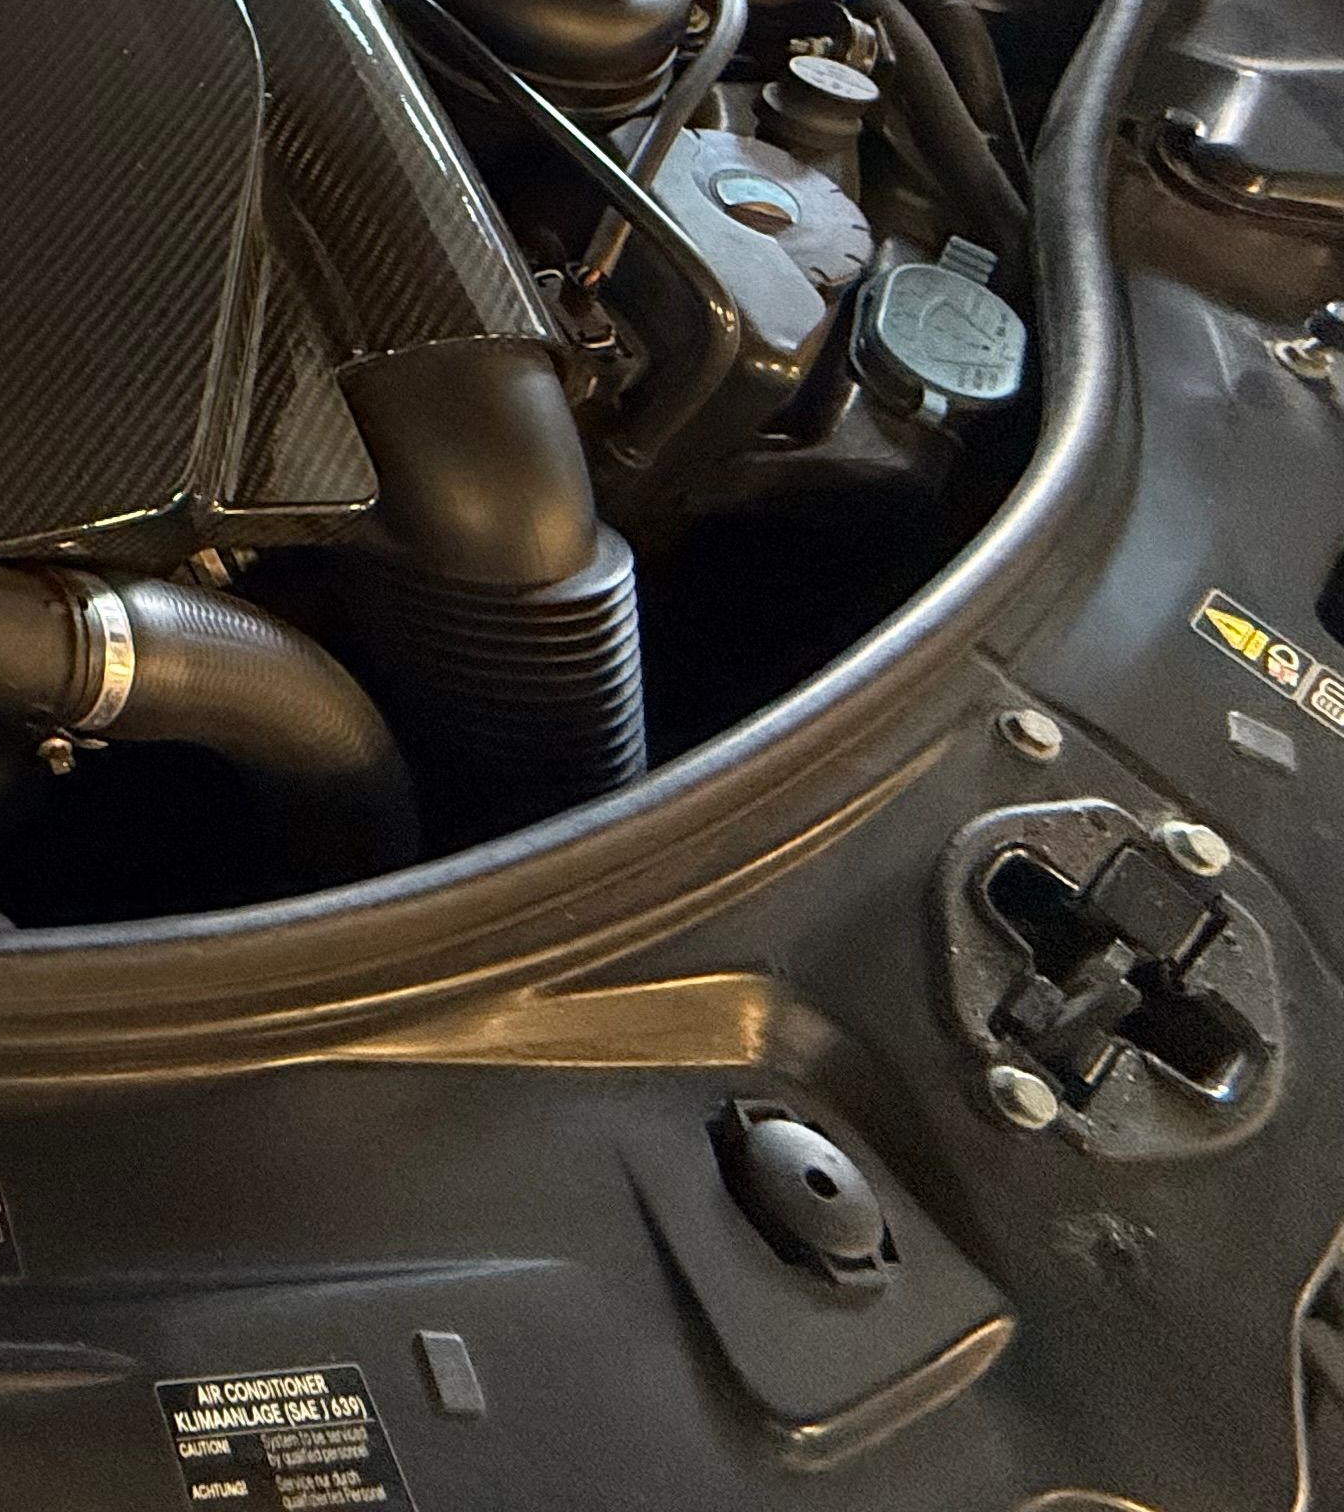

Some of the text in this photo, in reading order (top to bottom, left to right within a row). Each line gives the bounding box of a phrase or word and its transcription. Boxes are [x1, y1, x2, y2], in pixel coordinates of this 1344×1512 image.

[196, 1374, 330, 1406] AIR CONDITIONER
[174, 1402, 285, 1433] KLIMAANLAGE
[284, 1398, 319, 1427] (SAE
[330, 1394, 367, 1420] 639)
[179, 1439, 231, 1458] CAUTION!
[192, 1479, 248, 1500] ACHTUNG!
